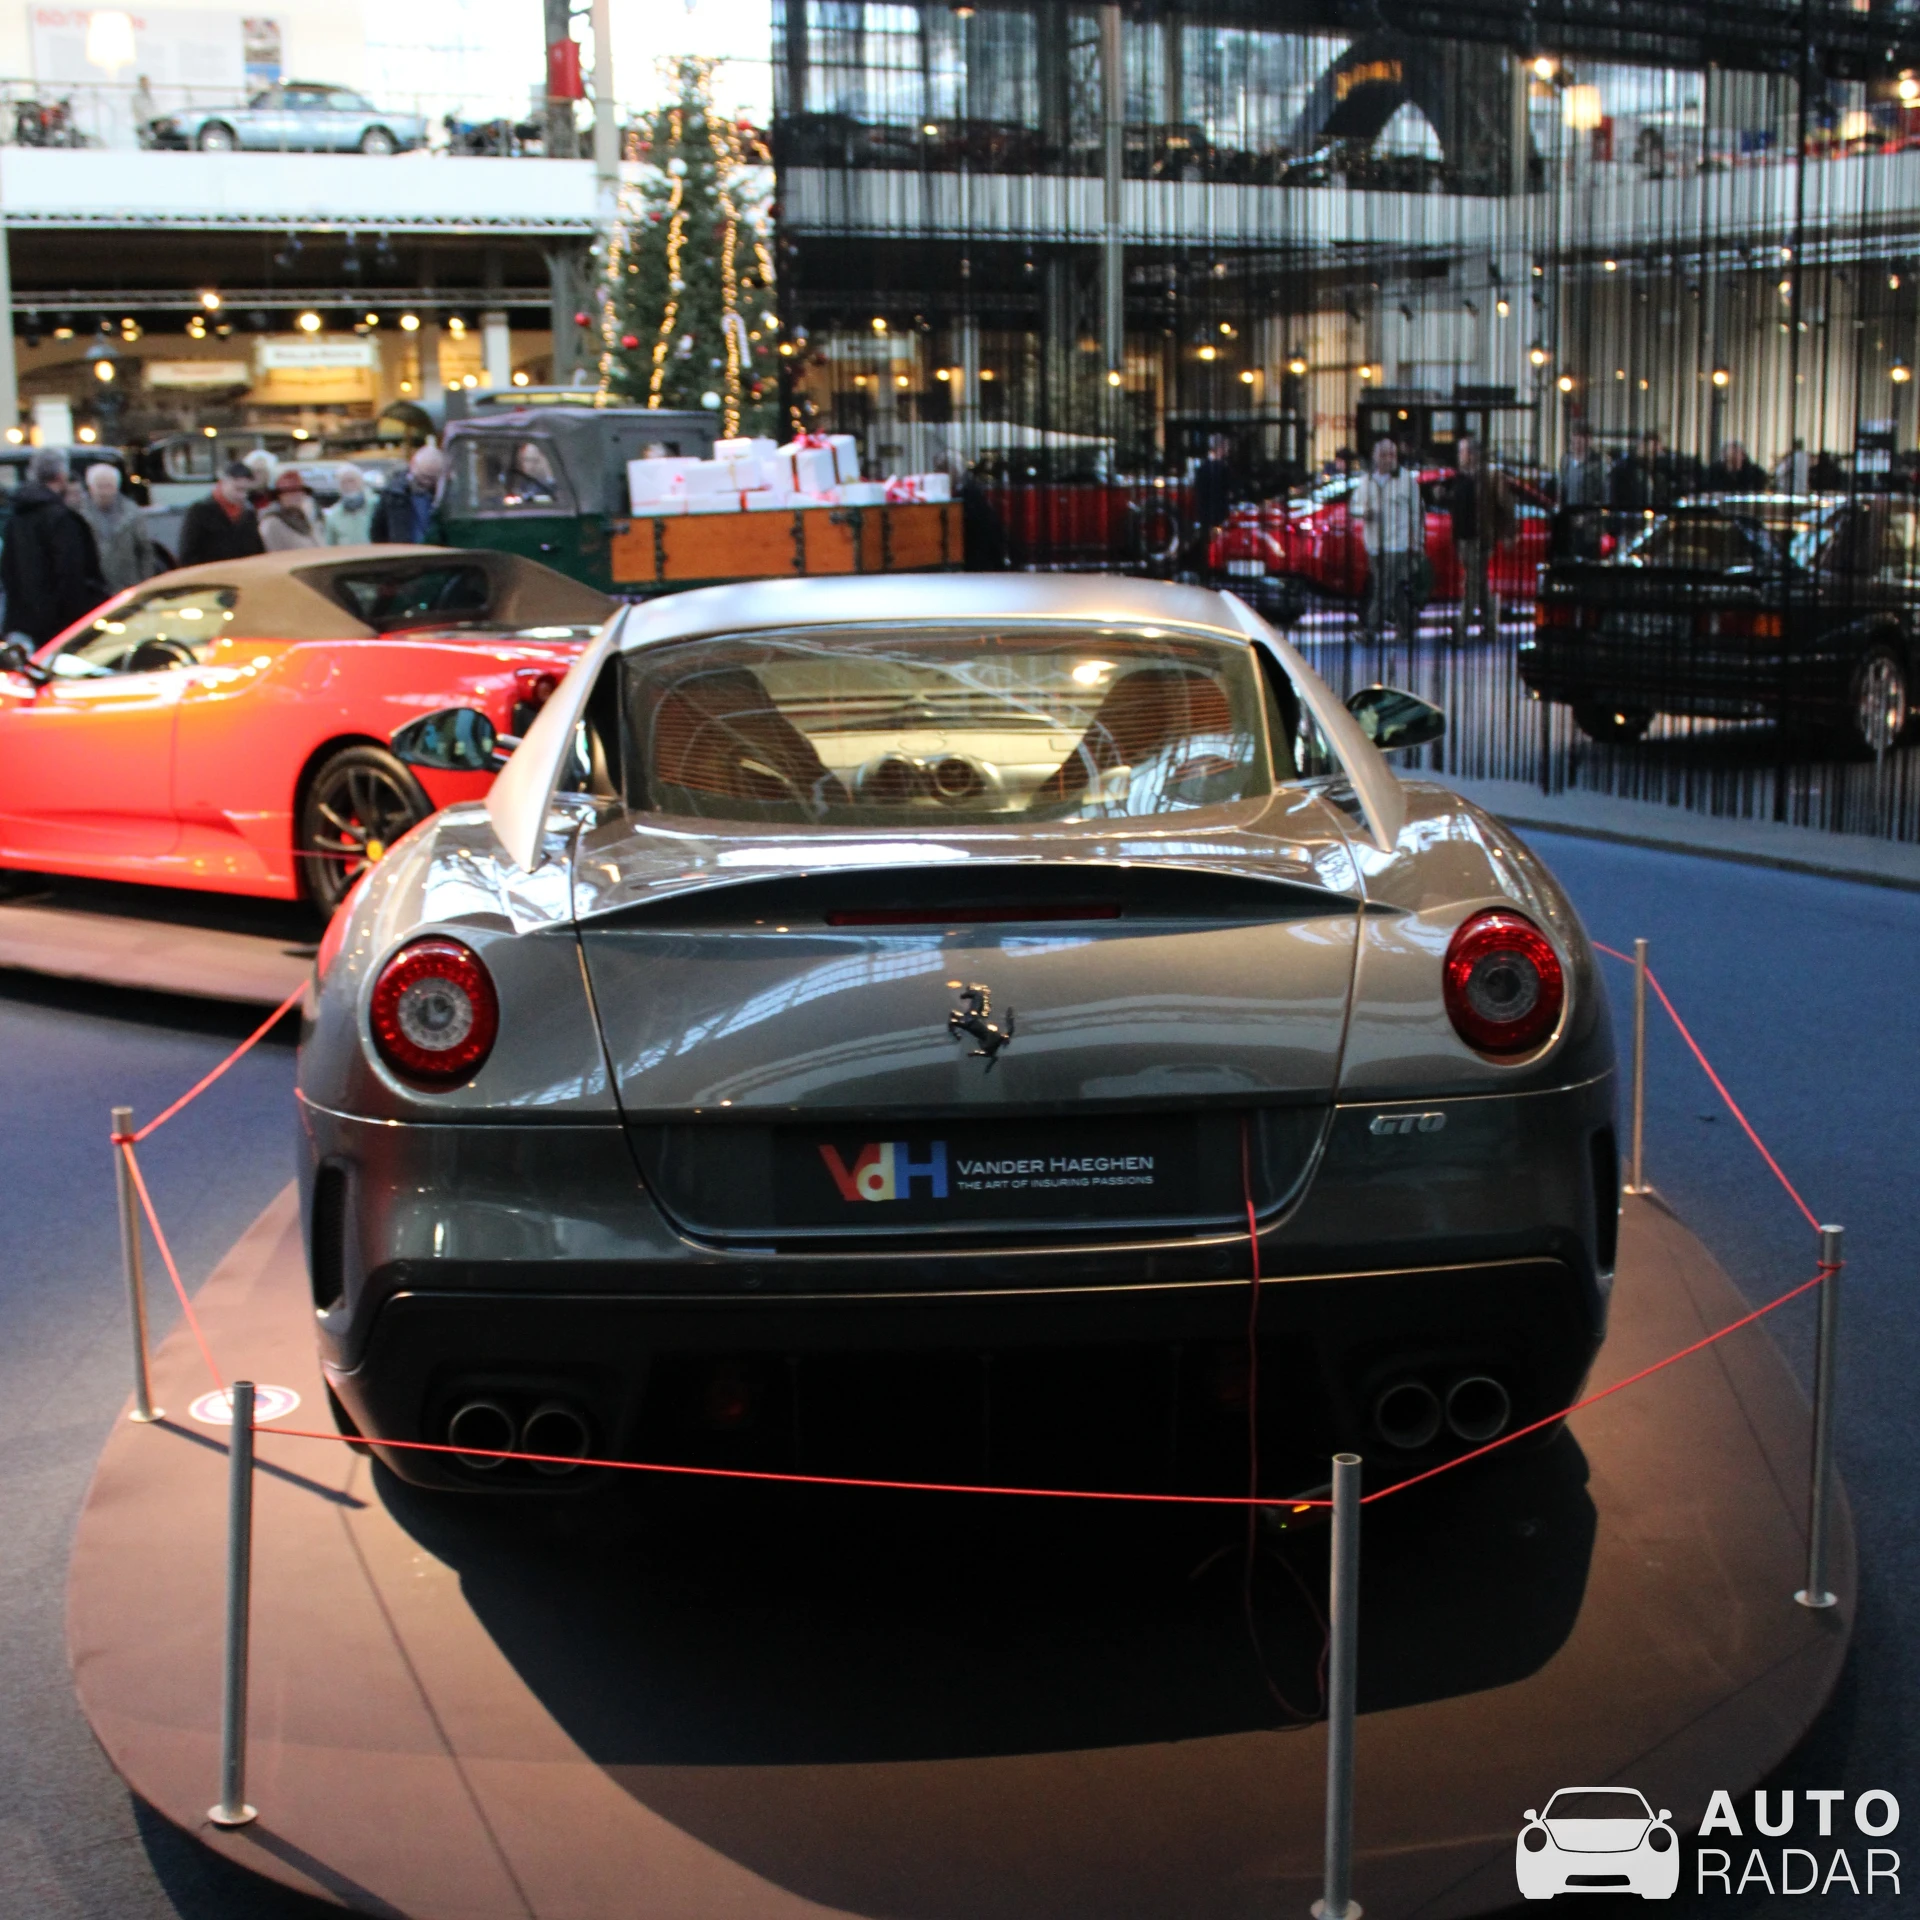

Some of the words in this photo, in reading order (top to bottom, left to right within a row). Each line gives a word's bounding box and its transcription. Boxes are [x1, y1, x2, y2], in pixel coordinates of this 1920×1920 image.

[1369, 1112, 1447, 1135] GTO
[956, 1159, 1045, 1176] VANDER
[1050, 1156, 1155, 1173] HAEGHEN
[957, 1181, 982, 1190] THE
[985, 1180, 1008, 1190] ART
[1012, 1179, 1028, 1189] OF
[1031, 1178, 1090, 1188] INSURING
[1092, 1175, 1154, 1186] PASSIONS
